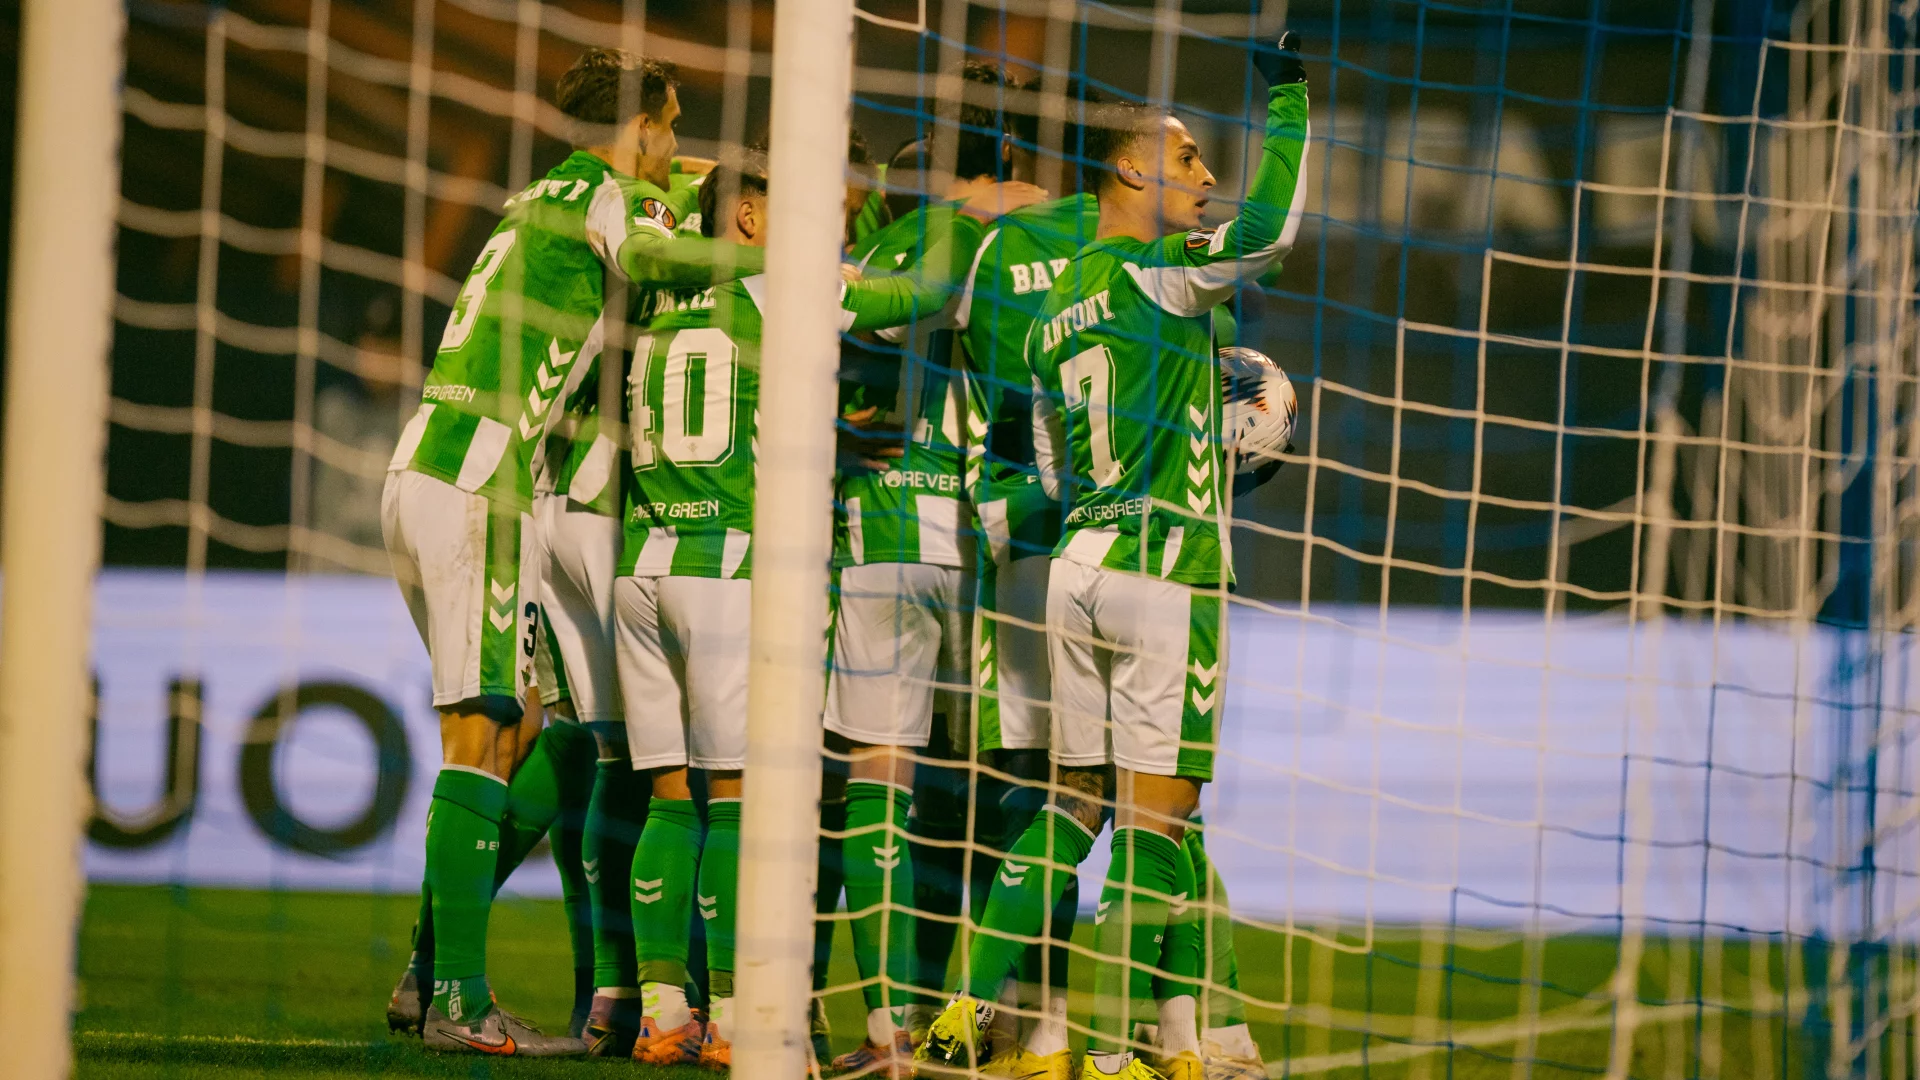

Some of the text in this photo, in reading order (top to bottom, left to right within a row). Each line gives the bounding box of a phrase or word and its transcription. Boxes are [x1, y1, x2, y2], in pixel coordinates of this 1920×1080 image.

[439, 228, 517, 353] 3
[1043, 289, 1116, 354] ANTONY
[438, 385, 477, 403] GREEN
[626, 328, 738, 473] 40
[1059, 343, 1126, 493] 7
[668, 500, 719, 518] GREEN
[523, 601, 538, 658] 3
